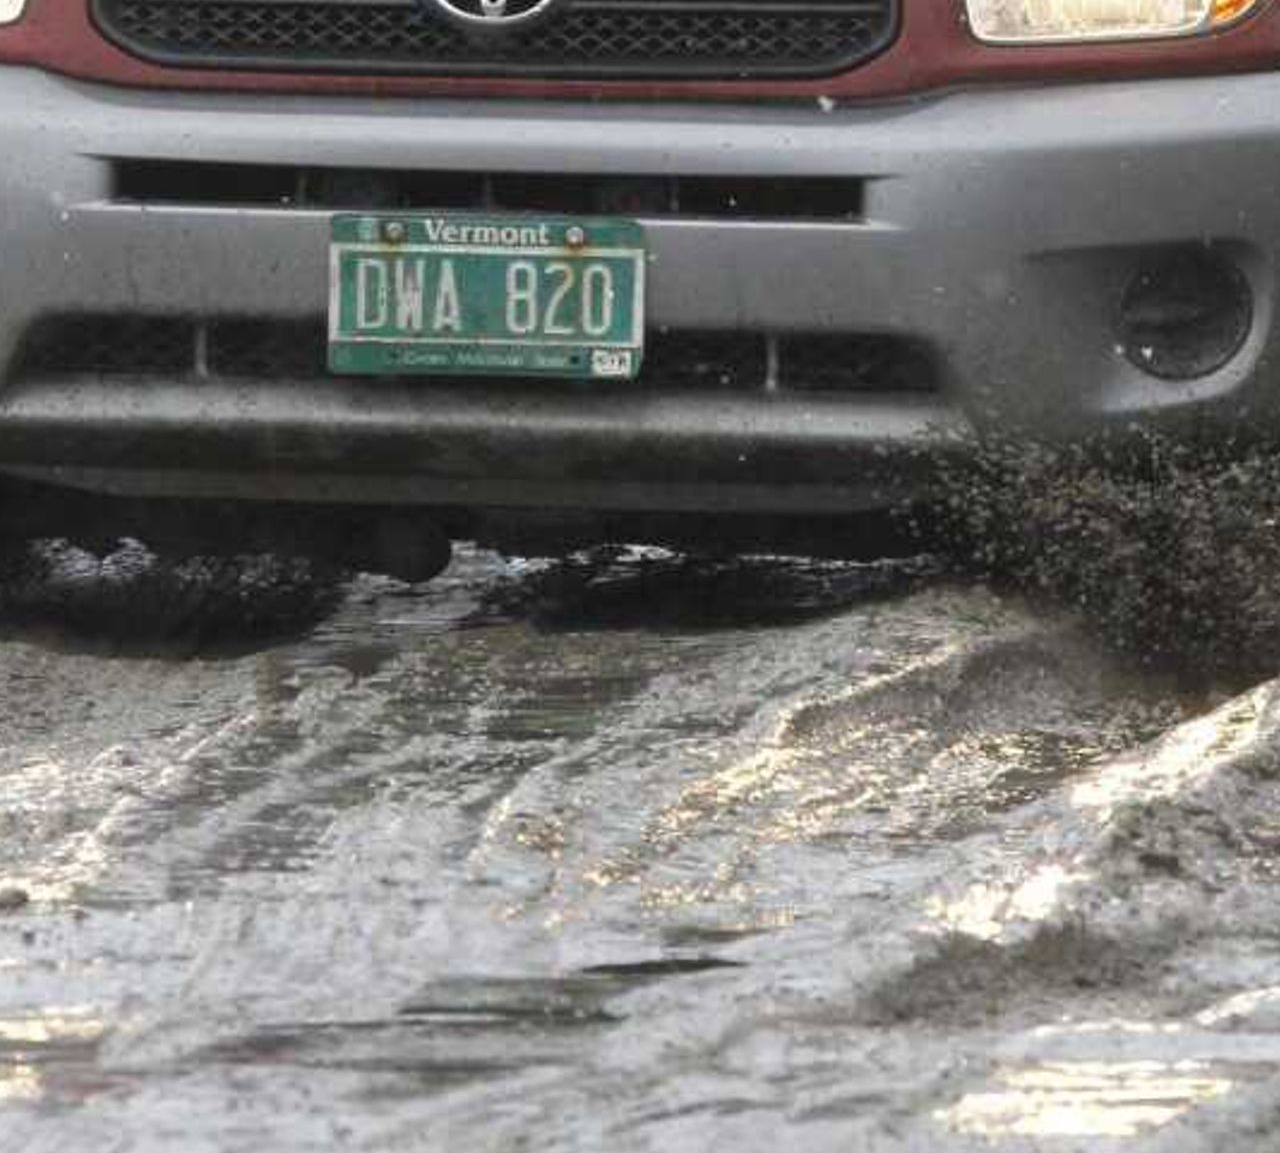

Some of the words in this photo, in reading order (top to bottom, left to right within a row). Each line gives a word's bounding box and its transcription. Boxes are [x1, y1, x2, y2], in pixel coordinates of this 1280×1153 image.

[424, 219, 550, 245] Vermont
[356, 258, 463, 332] DWA
[505, 261, 614, 336] 820
